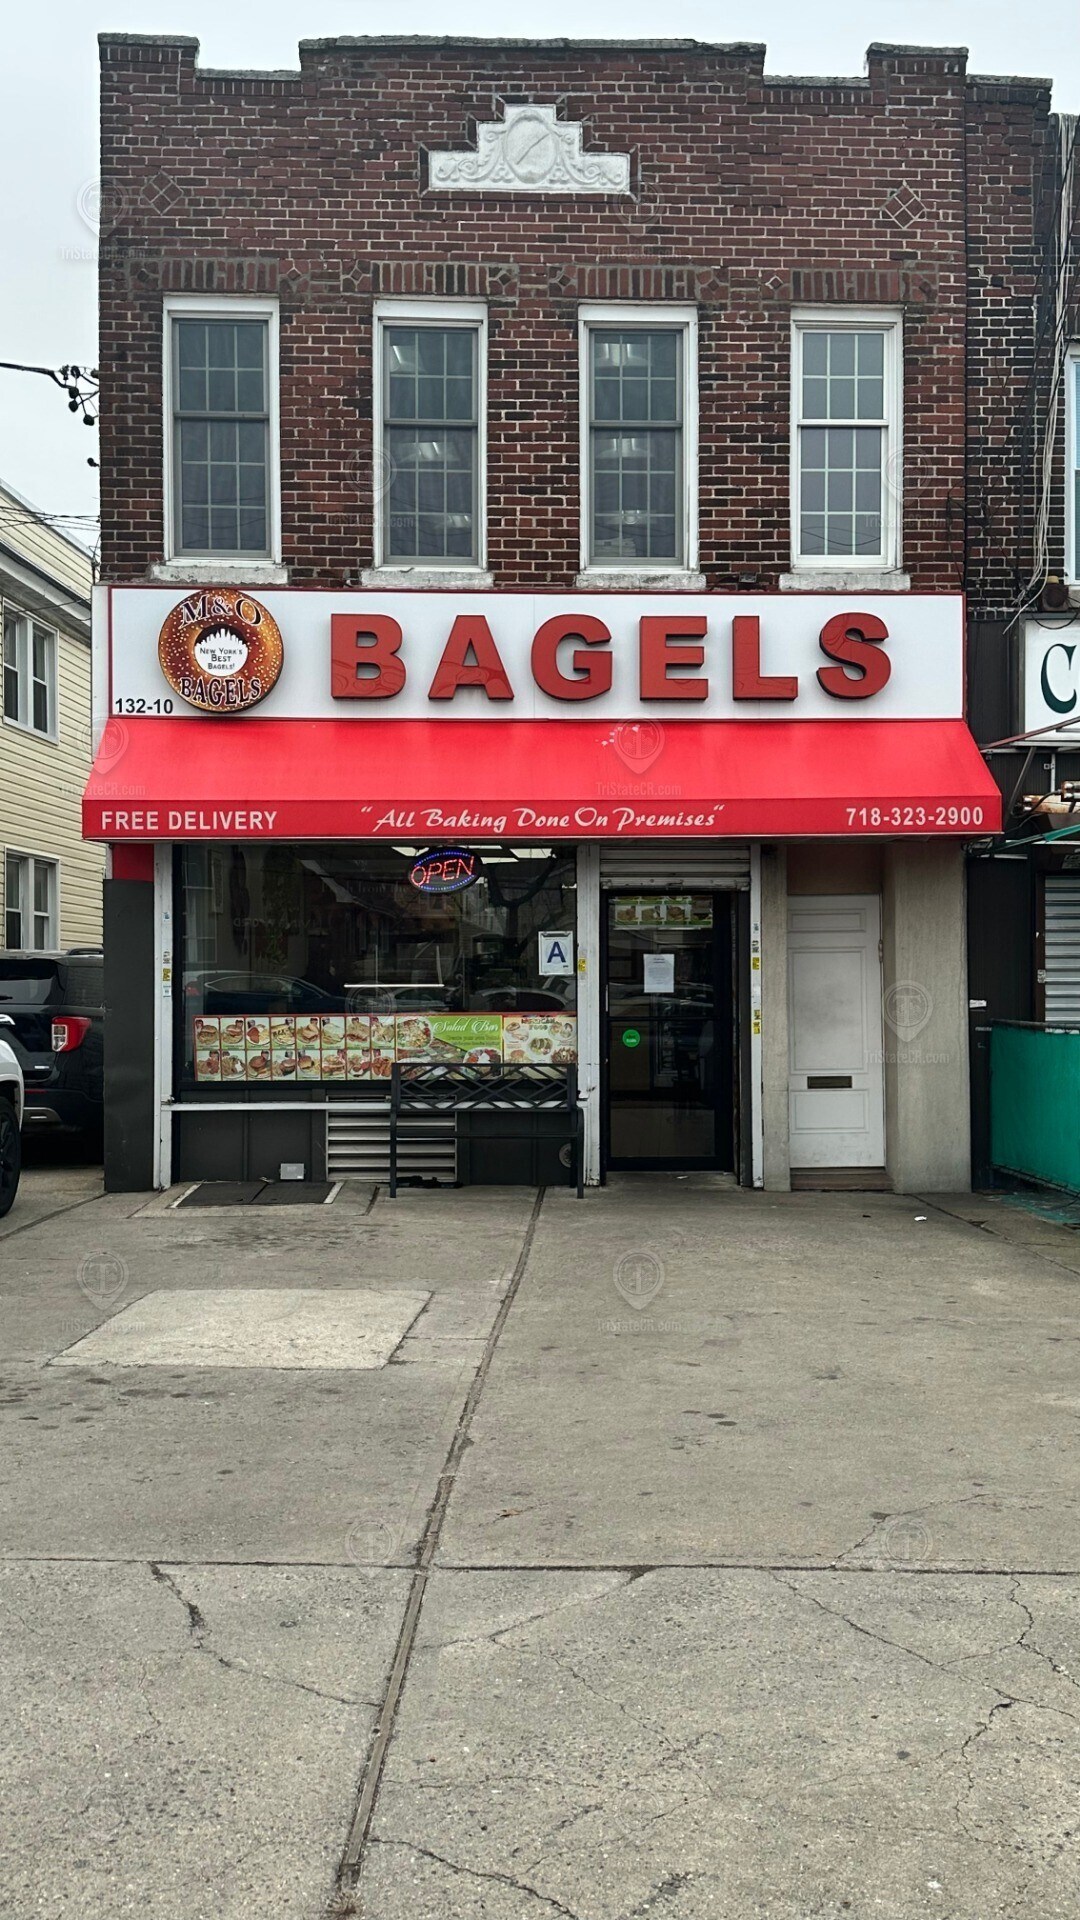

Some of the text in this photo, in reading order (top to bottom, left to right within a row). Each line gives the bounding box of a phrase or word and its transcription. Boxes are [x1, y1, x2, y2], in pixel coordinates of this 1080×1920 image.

[178, 594, 262, 629] M&O
[210, 654, 232, 662] BEST
[331, 612, 892, 701] BAGELS
[180, 676, 261, 706] BAGELS
[115, 698, 174, 714] 132-10
[101, 811, 277, 830] FREE DELIVERY
[420, 808, 507, 832] Baking
[512, 807, 570, 829] Done
[574, 806, 608, 828] On
[846, 806, 984, 826] 718-323-2900
[411, 856, 475, 887] OPEN
[547, 941, 566, 964] A
[434, 1015, 499, 1034] Salad Bar
